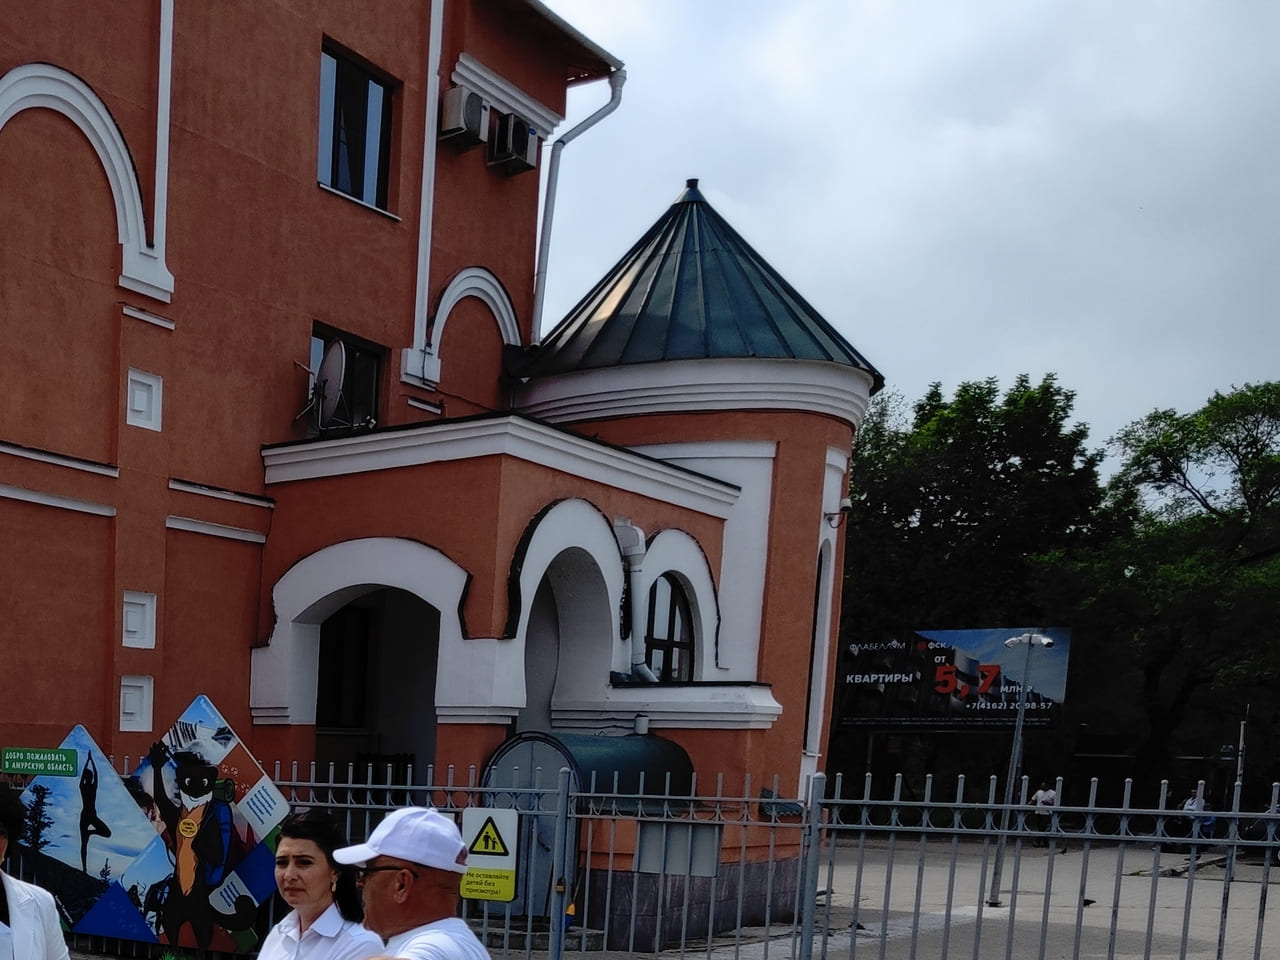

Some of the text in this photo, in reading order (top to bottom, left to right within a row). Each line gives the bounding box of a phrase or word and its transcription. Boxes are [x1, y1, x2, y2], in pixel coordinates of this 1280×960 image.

[846, 673, 914, 684] КВАРТИРЫ
[935, 665, 1001, 698] 5,7
[966, 702, 1007, 710] +7(4162)
[5, 752, 66, 762] ДОБРО ПОЖАЛОВАТЬ
[11, 762, 45, 770] АМУРСКУЮ
[47, 763, 74, 772] ОБЛАСТЬ
